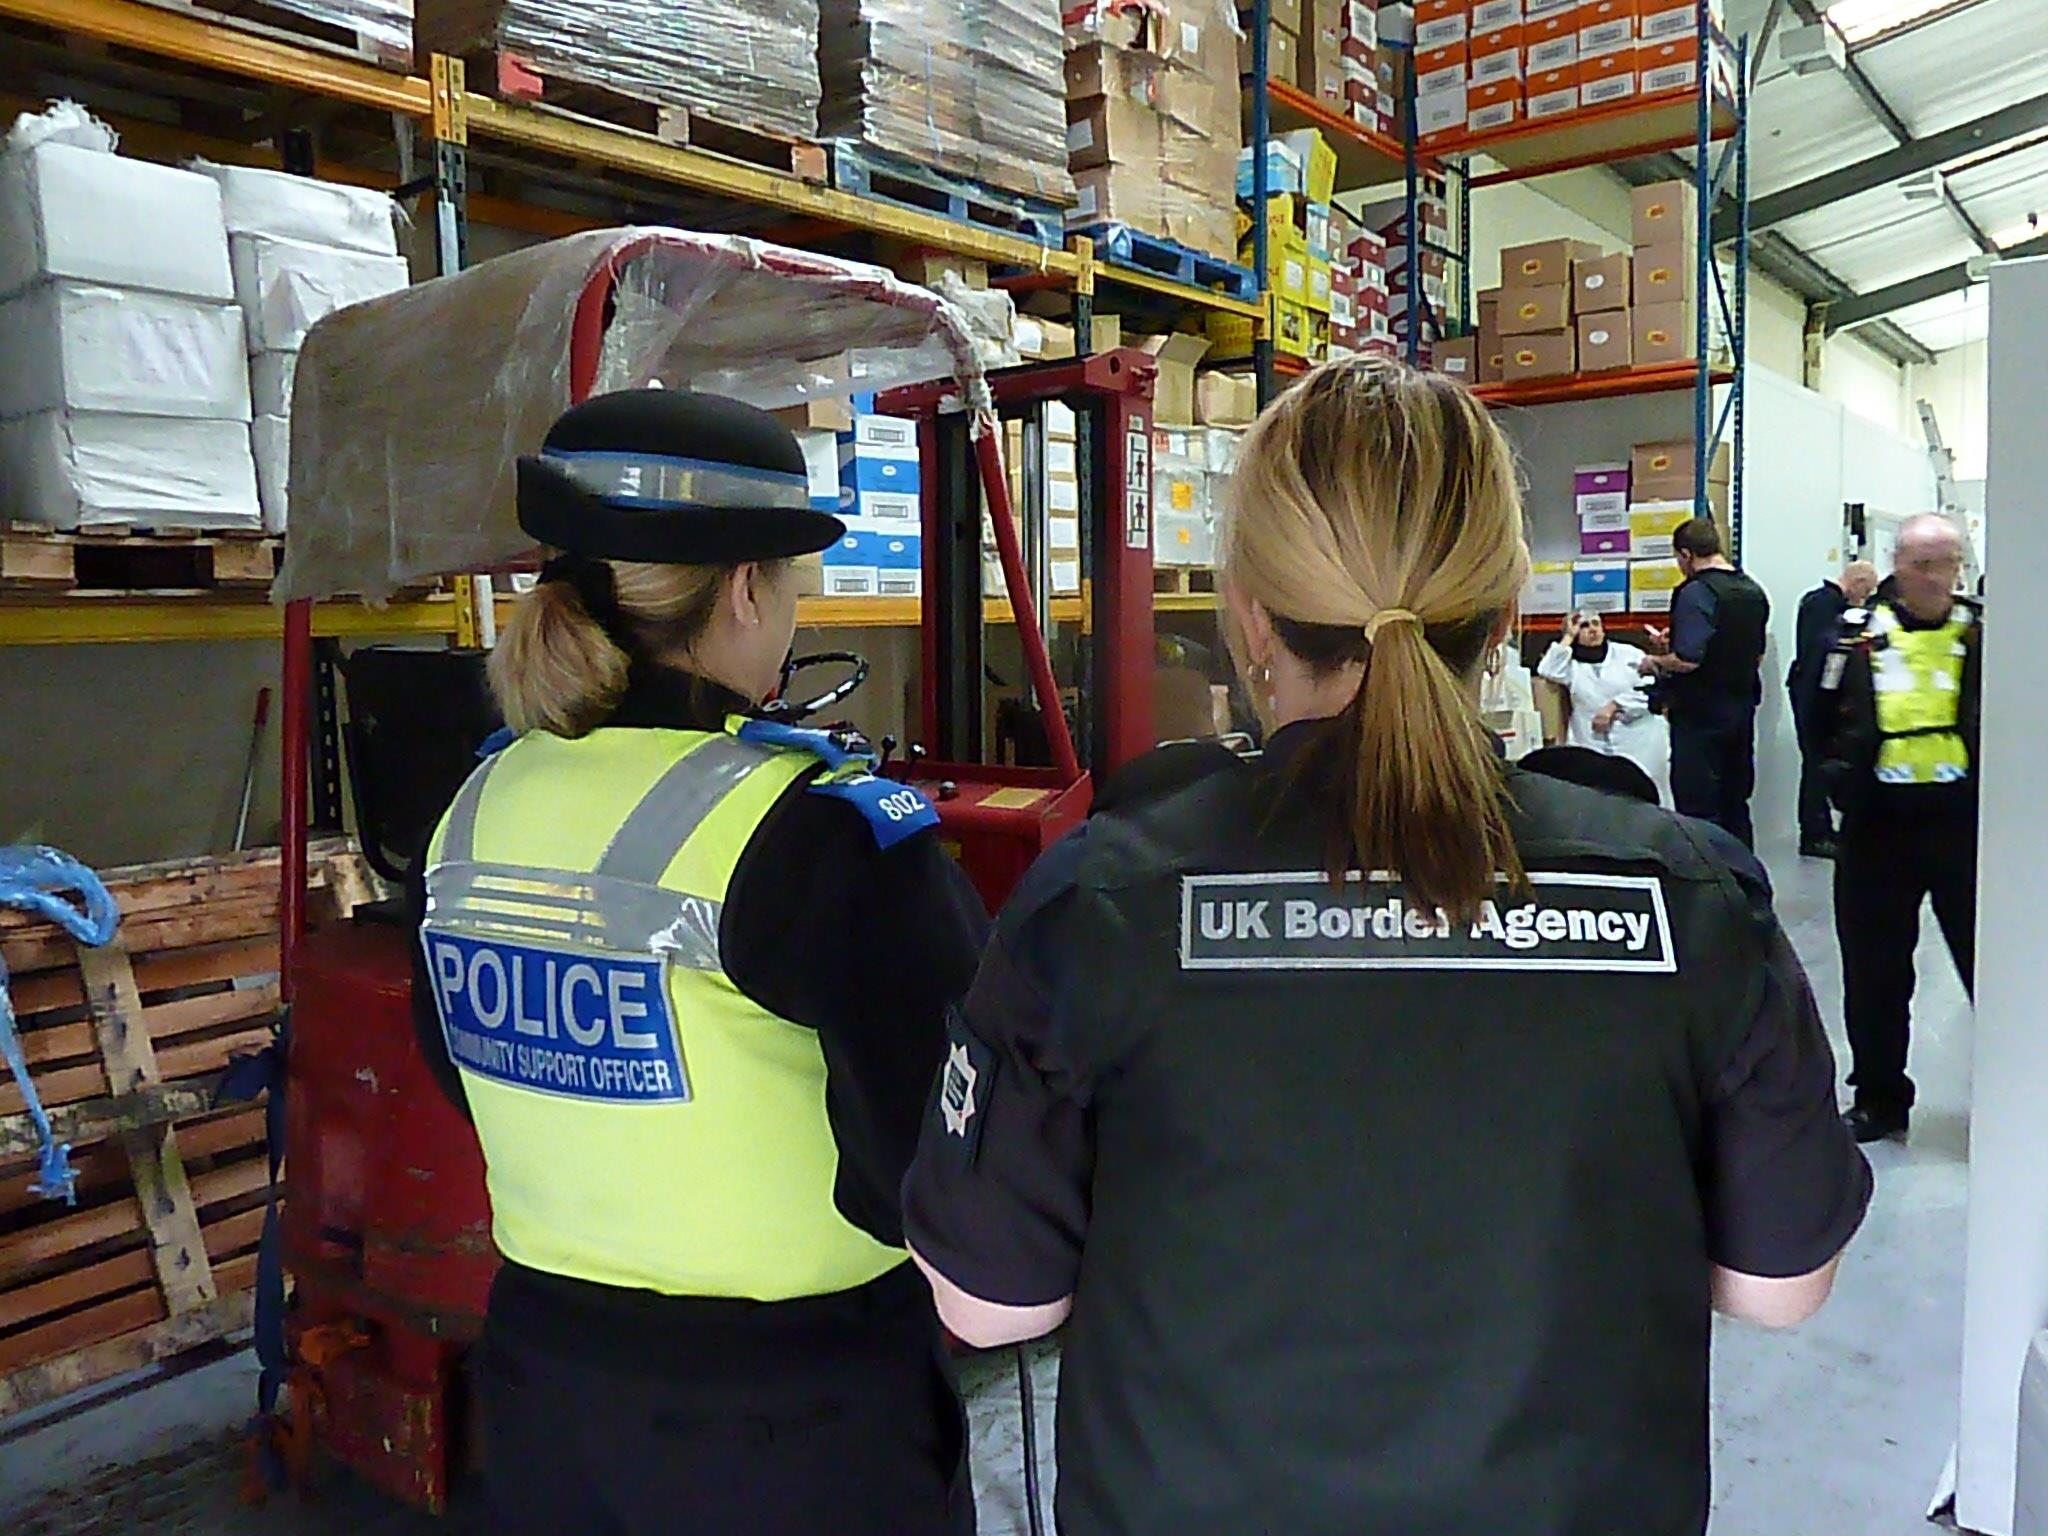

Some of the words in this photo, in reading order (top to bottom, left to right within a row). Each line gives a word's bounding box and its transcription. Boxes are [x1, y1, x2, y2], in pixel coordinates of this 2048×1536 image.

[879, 790, 926, 821] 802
[1200, 901, 1271, 940] UK
[1470, 899, 1650, 951] Agency
[434, 941, 659, 1049] POLICE
[449, 1024, 515, 1075] UNITY
[518, 1043, 587, 1088] SUPPORT
[590, 1056, 673, 1093] OFFICER
